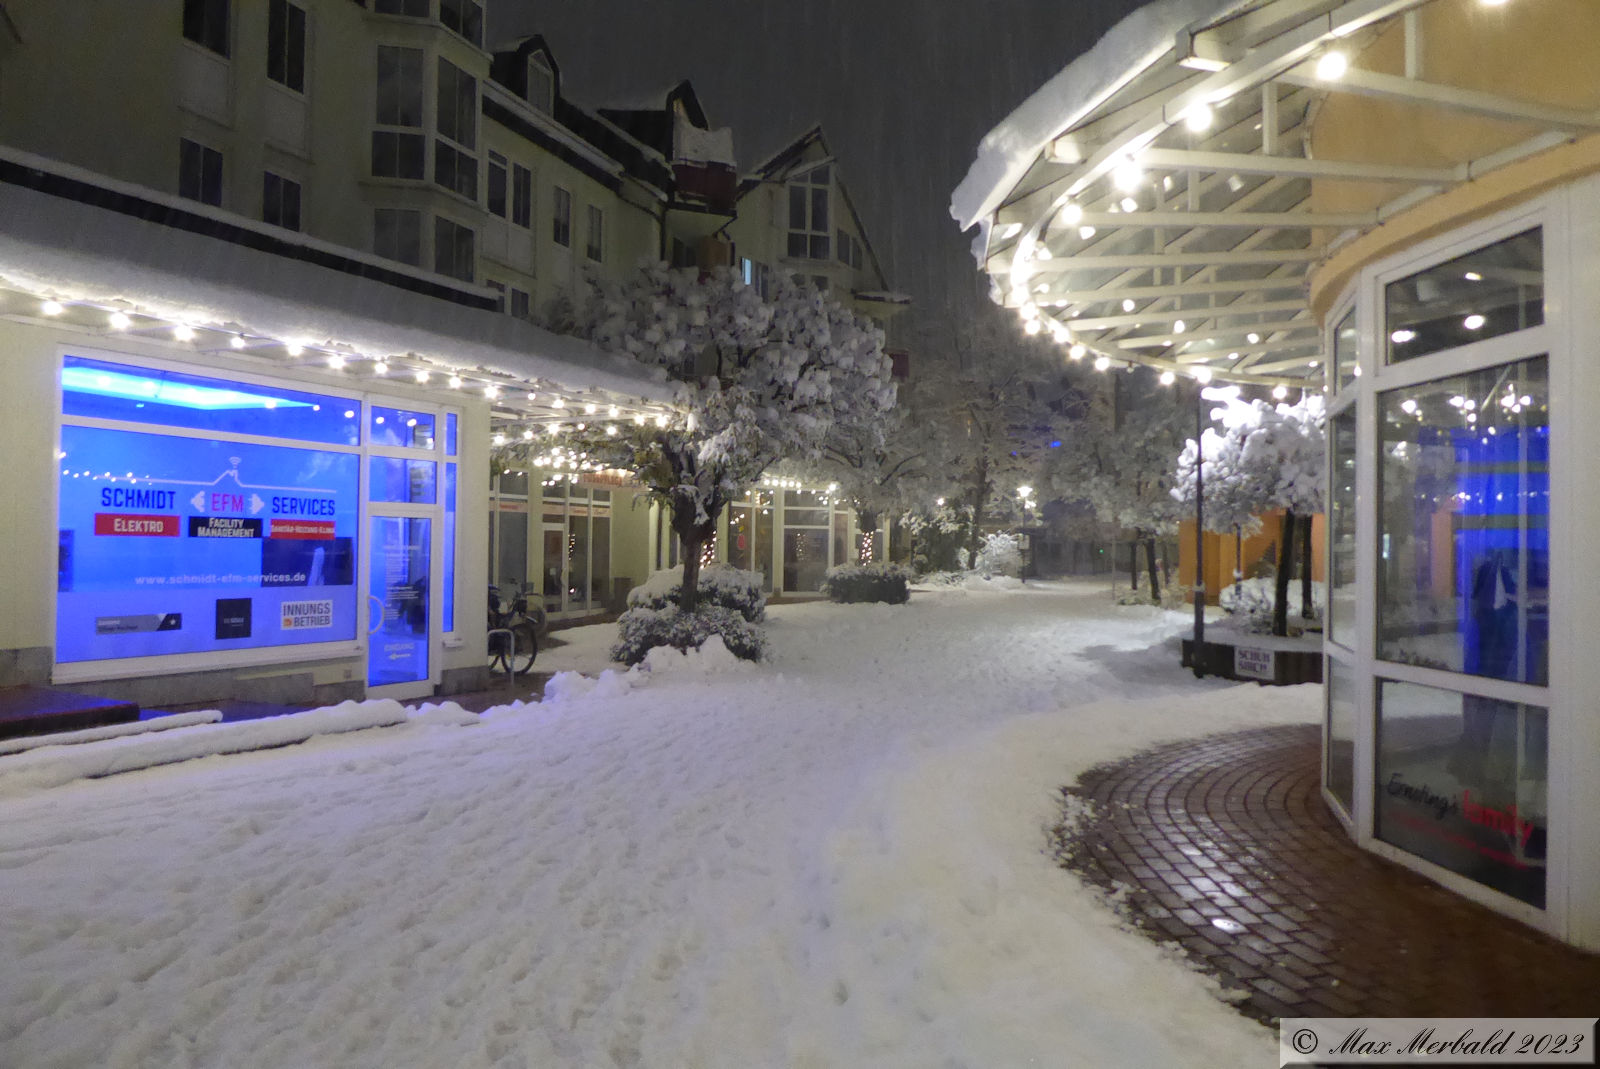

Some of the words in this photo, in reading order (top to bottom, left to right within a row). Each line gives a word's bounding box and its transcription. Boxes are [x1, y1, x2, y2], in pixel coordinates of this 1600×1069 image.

[101, 487, 176, 510] SCHMIDT
[211, 493, 244, 512] EFM
[272, 496, 336, 516] SERVICES
[114, 518, 163, 533] ELEKTRO
[209, 517, 244, 528] FACILITY
[197, 526, 255, 538] MANAGEMENT
[135, 572, 306, 585] www.schmidt-efm-services.de
[283, 603, 331, 616] INNUNGS
[294, 616, 330, 627] BETRIEB
